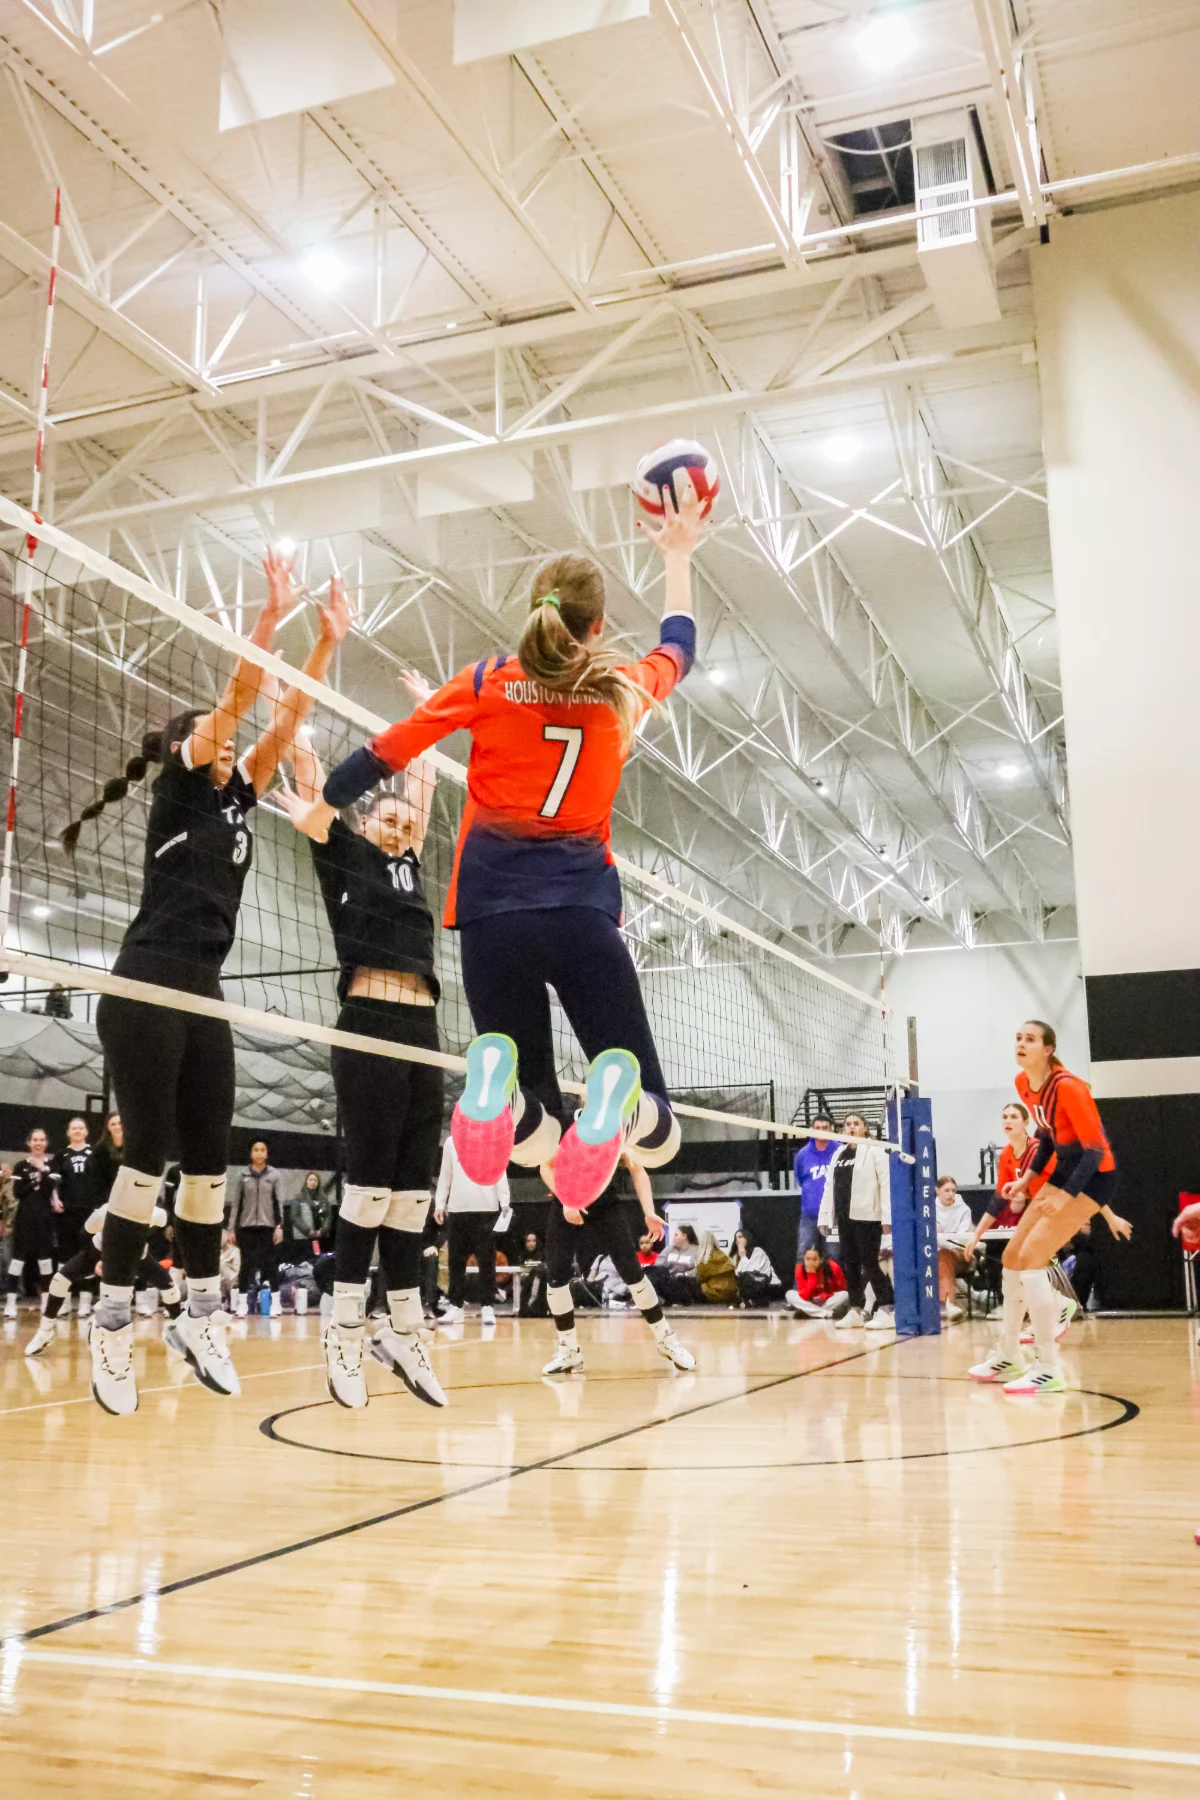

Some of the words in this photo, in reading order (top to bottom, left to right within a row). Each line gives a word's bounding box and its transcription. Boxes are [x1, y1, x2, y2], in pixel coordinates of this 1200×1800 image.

[538, 724, 584, 818] 7
[221, 805, 245, 824] TA
[232, 830, 248, 864] 3
[387, 862, 414, 892] 10
[1033, 1103, 1053, 1130] 11
[72, 1162, 85, 1173] 11
[921, 1145, 934, 1299] AMERICAN
